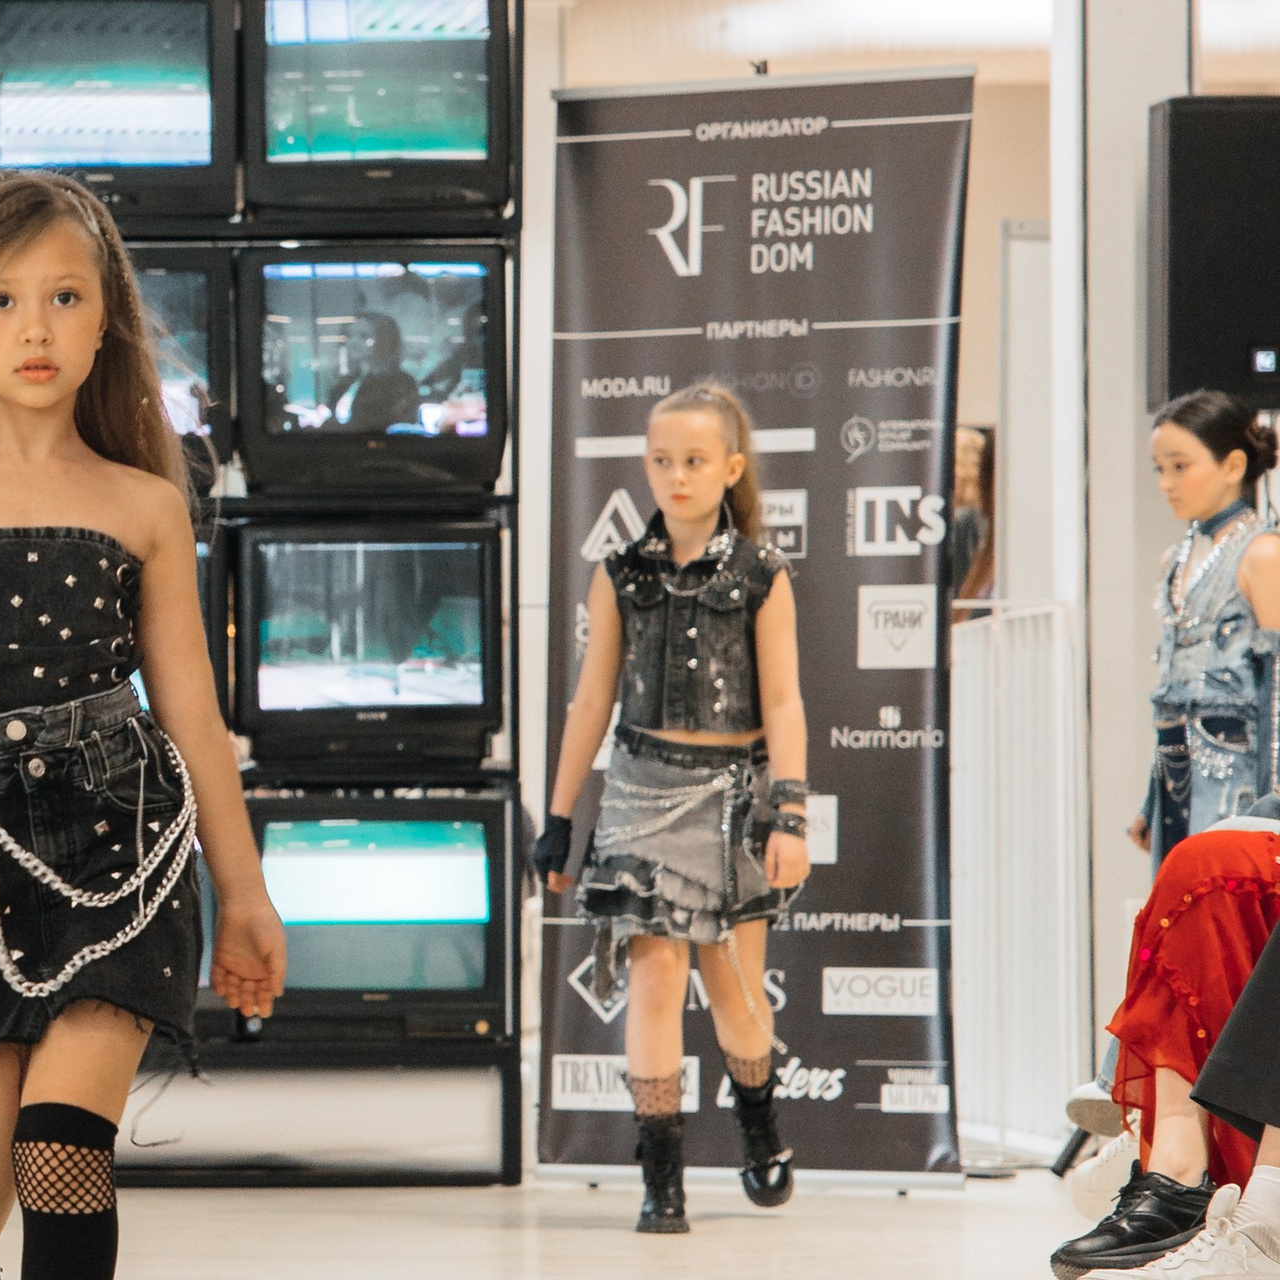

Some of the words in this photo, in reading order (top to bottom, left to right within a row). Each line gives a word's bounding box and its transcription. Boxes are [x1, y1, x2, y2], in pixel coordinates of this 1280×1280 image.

[695, 116, 829, 141] ОРГАНИЗАТОР
[750, 167, 873, 203] RUSSIAN
[750, 202, 874, 238] FASHION
[749, 240, 814, 274] DOM
[705, 318, 809, 340] ПАРТНЕРЫ
[580, 375, 671, 399] MODA.RU
[873, 610, 924, 630] ГРАНИ
[830, 724, 945, 749] Narmania
[793, 911, 902, 932] ПАРТНЕРЫ
[828, 974, 933, 999] VOGUE
